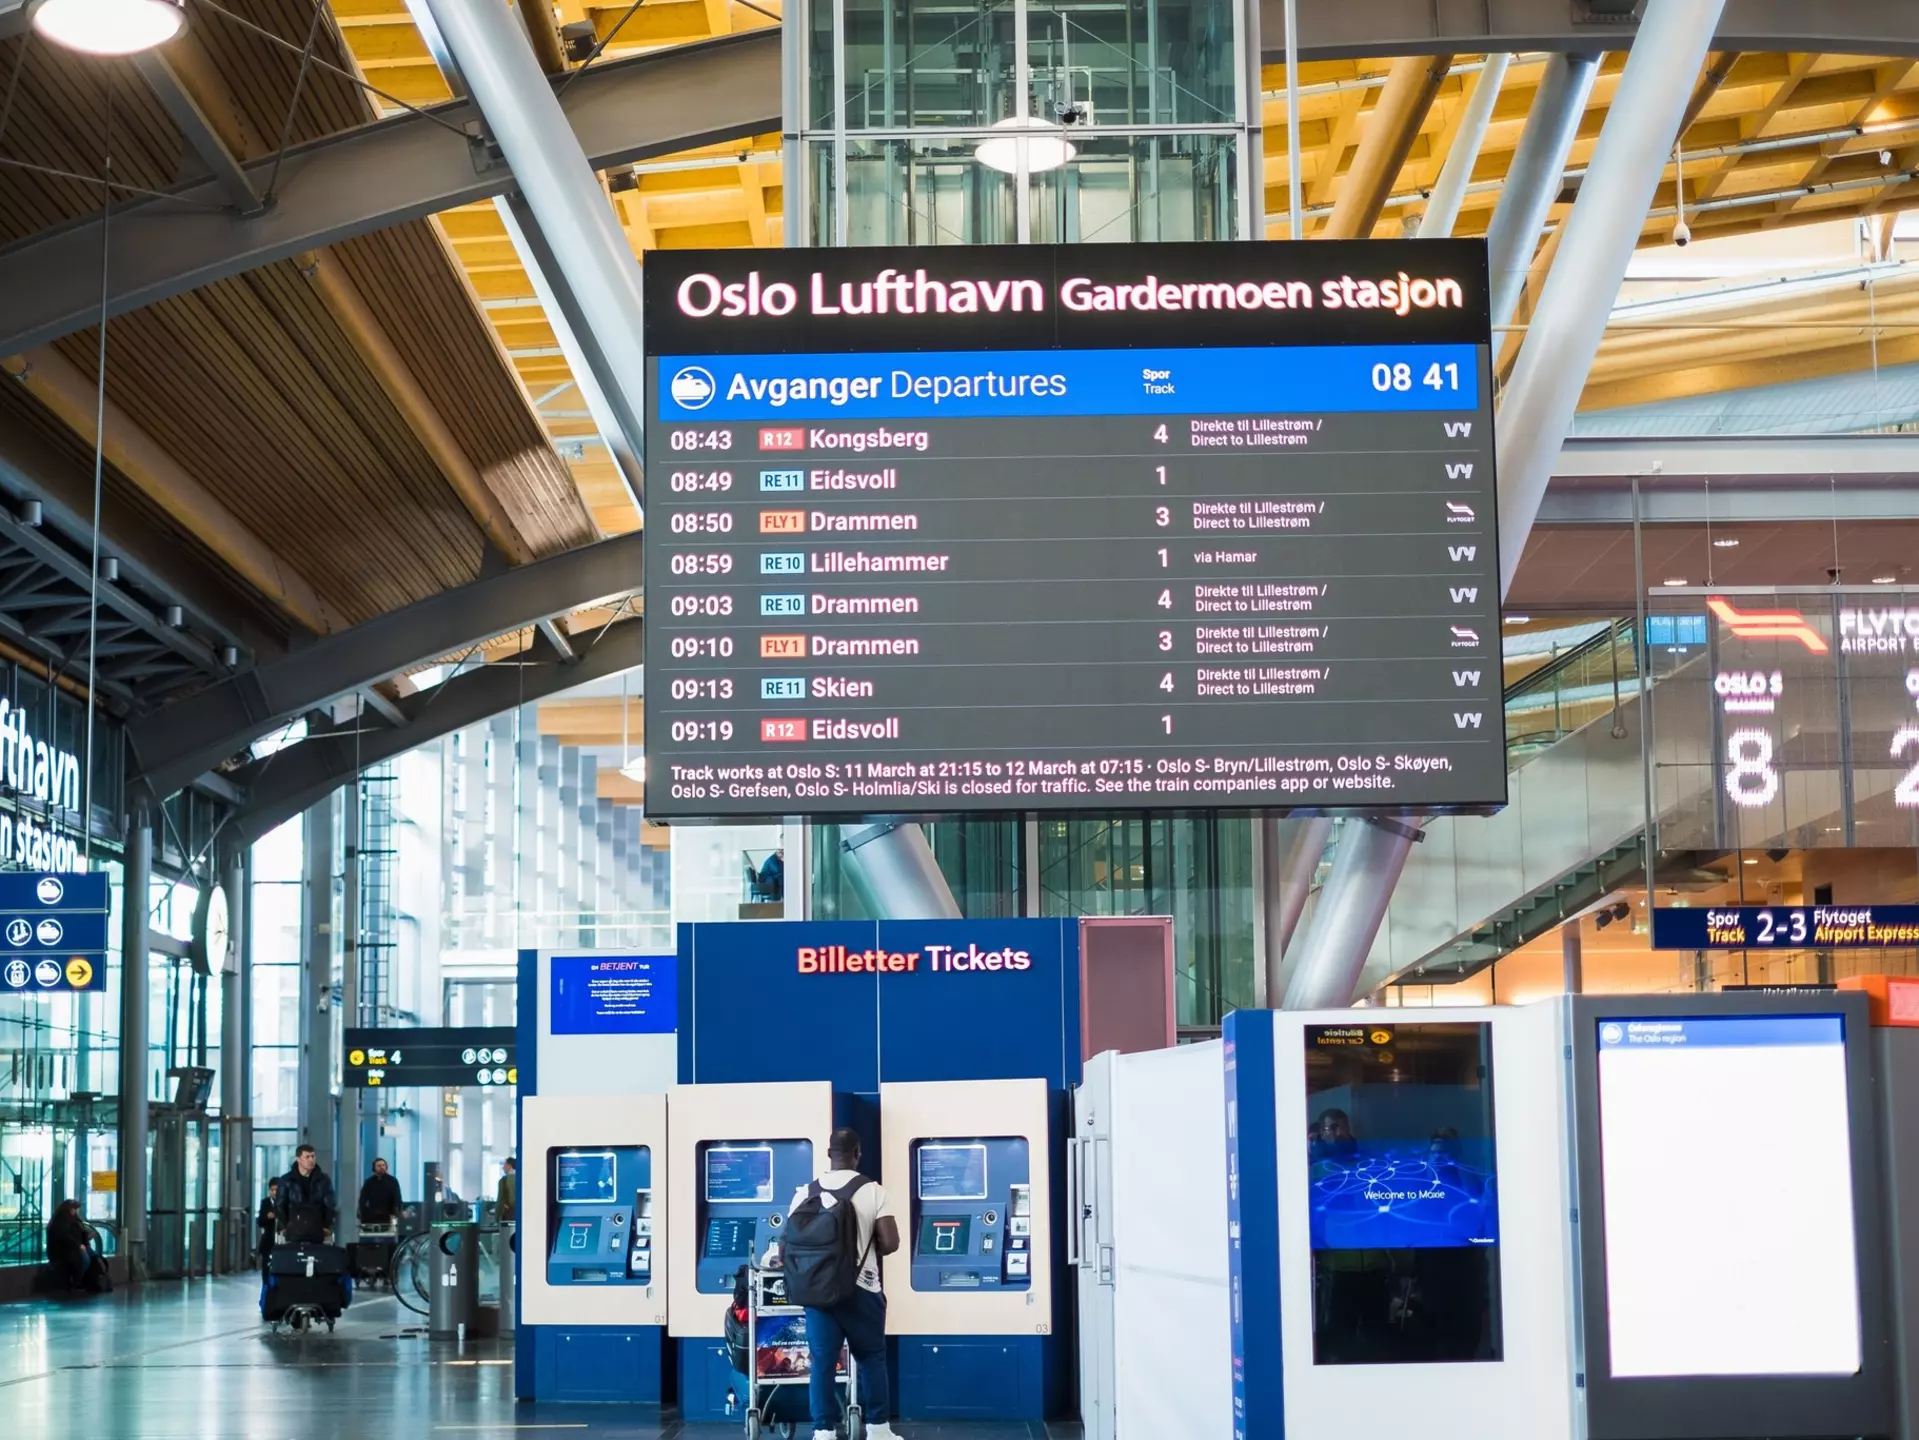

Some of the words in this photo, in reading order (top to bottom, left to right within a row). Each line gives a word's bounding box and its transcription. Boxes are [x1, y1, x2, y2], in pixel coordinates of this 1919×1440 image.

[677, 271, 797, 317] Oslo
[811, 269, 1044, 316] Lufthavn
[1061, 275, 1312, 311] Gardermoen
[1321, 272, 1463, 316] stasjon
[1143, 369, 1170, 381] Spor
[1372, 363, 1411, 391] 08
[1423, 362, 1459, 391] 41
[727, 372, 882, 406] Avganger
[891, 370, 1067, 404] Departures
[1144, 382, 1175, 394] Track
[1192, 420, 1234, 431] Direkte
[1237, 420, 1249, 431] til
[1253, 419, 1313, 431] Lillestrøm
[671, 431, 732, 450] 08:43
[810, 428, 928, 452] Kongsberg
[1154, 424, 1168, 444] 4
[1192, 435, 1227, 446] Direct
[1231, 435, 1243, 445] to
[1247, 434, 1307, 445] Lillestrøm
[671, 472, 732, 491] 08:49
[810, 469, 896, 490] Eidsvoll
[1156, 466, 1166, 485] 1
[1194, 502, 1236, 514] Direkte
[1240, 502, 1251, 513] til
[1255, 501, 1315, 513] Lillestrøm
[671, 513, 732, 533] 08:50
[811, 512, 917, 531] Drammen
[1156, 507, 1169, 526] 3
[1194, 518, 1229, 529] Direct
[1233, 518, 1245, 528] to
[1249, 516, 1309, 528] Lillestrøm
[671, 554, 732, 574] 08:59
[811, 552, 949, 573] Lillehammer
[1158, 549, 1168, 568] 1
[1194, 551, 1213, 562] via
[1216, 551, 1258, 563] Hamar
[1196, 585, 1238, 597] Direkte
[1242, 585, 1253, 596] til
[1257, 584, 1317, 596] Lillestrøm
[671, 596, 733, 616] 09:03
[811, 594, 919, 614] Drammen
[1158, 590, 1172, 609] 4
[1196, 601, 1231, 612] Direct
[1235, 601, 1247, 611] to
[1252, 599, 1312, 611] Lillestrøm
[672, 637, 733, 657] 09:10
[811, 636, 919, 656] Drammen
[1159, 631, 1173, 650] 3
[1197, 627, 1239, 639] Direkte
[1243, 627, 1254, 638] til
[1259, 626, 1319, 638] Lillestrøm
[1197, 642, 1232, 653] Direct
[1236, 642, 1248, 653] to
[1252, 641, 1313, 652] Lillestrøm
[1841, 638, 1906, 652] AIRPORT
[1198, 669, 1240, 680] Direkte
[1244, 668, 1255, 679] til
[1260, 668, 1320, 679] Lillestrøm
[1715, 671, 1767, 696] OSLO
[1769, 670, 1783, 697] S
[672, 679, 733, 699] 09:13
[812, 677, 873, 698] Skien
[1160, 673, 1174, 692] 4
[1198, 684, 1233, 695] Direct
[1237, 684, 1249, 695] to
[1254, 683, 1314, 694] Lillestrøm
[672, 720, 733, 741] 09:19
[812, 718, 899, 740] Eidsvoll
[1162, 715, 1171, 735] 1
[671, 766, 713, 780] Track
[718, 765, 763, 779] works
[768, 766, 782, 778] at
[787, 764, 821, 778] Oslo
[826, 764, 839, 778] S:
[845, 764, 861, 777] 11
[868, 763, 915, 777] March
[920, 764, 934, 776] at
[939, 762, 981, 776] 21:15
[986, 763, 1001, 775] to
[1006, 762, 1024, 775] 12
[1029, 760, 1076, 775] March
[1081, 761, 1095, 774] at
[1100, 760, 1142, 773] 07:15
[1157, 759, 1190, 773] Oslo
[1196, 759, 1209, 772] S-
[1215, 758, 1333, 775] Bryn/Lillestrøm,
[1338, 757, 1371, 770] Oslo
[1376, 757, 1390, 770] S-
[1395, 756, 1452, 772] Skøyen,
[1726, 728, 1778, 807] 8
[672, 784, 705, 798] Oslo
[710, 784, 724, 797] S-
[729, 783, 791, 798] Grefsen,
[796, 782, 829, 796] Oslo
[834, 782, 848, 795] S-
[853, 781, 940, 795] Holmlia/Ski
[945, 781, 957, 794] is
[962, 780, 1011, 794] closed
[1016, 779, 1037, 793] for
[1041, 778, 1090, 792] traffic.
[1096, 778, 1123, 792] See
[1127, 778, 1151, 791] the
[1155, 778, 1189, 791] train
[1194, 776, 1276, 793] companies
[1281, 779, 1308, 792] app
[1313, 778, 1328, 788] or
[1333, 775, 1394, 788] website.
[1707, 911, 1740, 926] Spor
[1757, 913, 1807, 942] 2-3
[1814, 909, 1872, 926] Flytoget
[1708, 928, 1745, 943] Track
[1814, 926, 1864, 945] Airport
[1867, 925, 1919, 945] Express
[798, 945, 919, 973] Billetter
[925, 943, 1031, 971] Tickets
[390, 1050, 401, 1064] 4
[1364, 1190, 1405, 1199] Welcome
[1407, 1191, 1416, 1199] to
